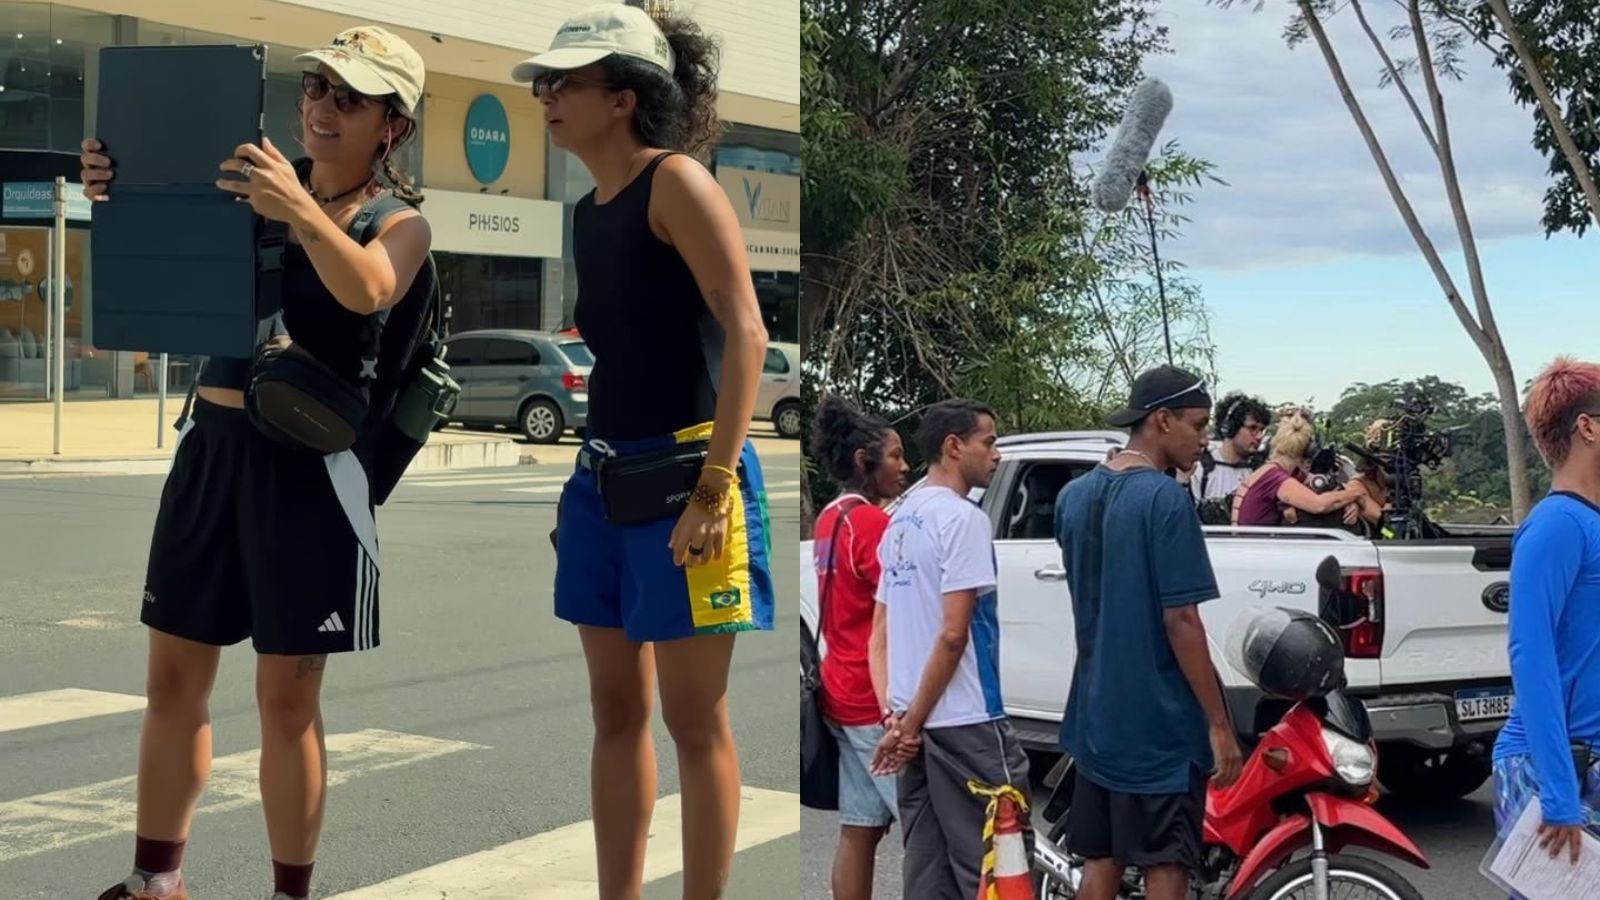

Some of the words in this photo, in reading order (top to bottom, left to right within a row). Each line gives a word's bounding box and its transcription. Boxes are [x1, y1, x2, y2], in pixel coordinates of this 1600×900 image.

[471, 128, 506, 142] ODARA
[1248, 579, 1306, 598] 4WD
[1461, 696, 1509, 717] SLT3H85
